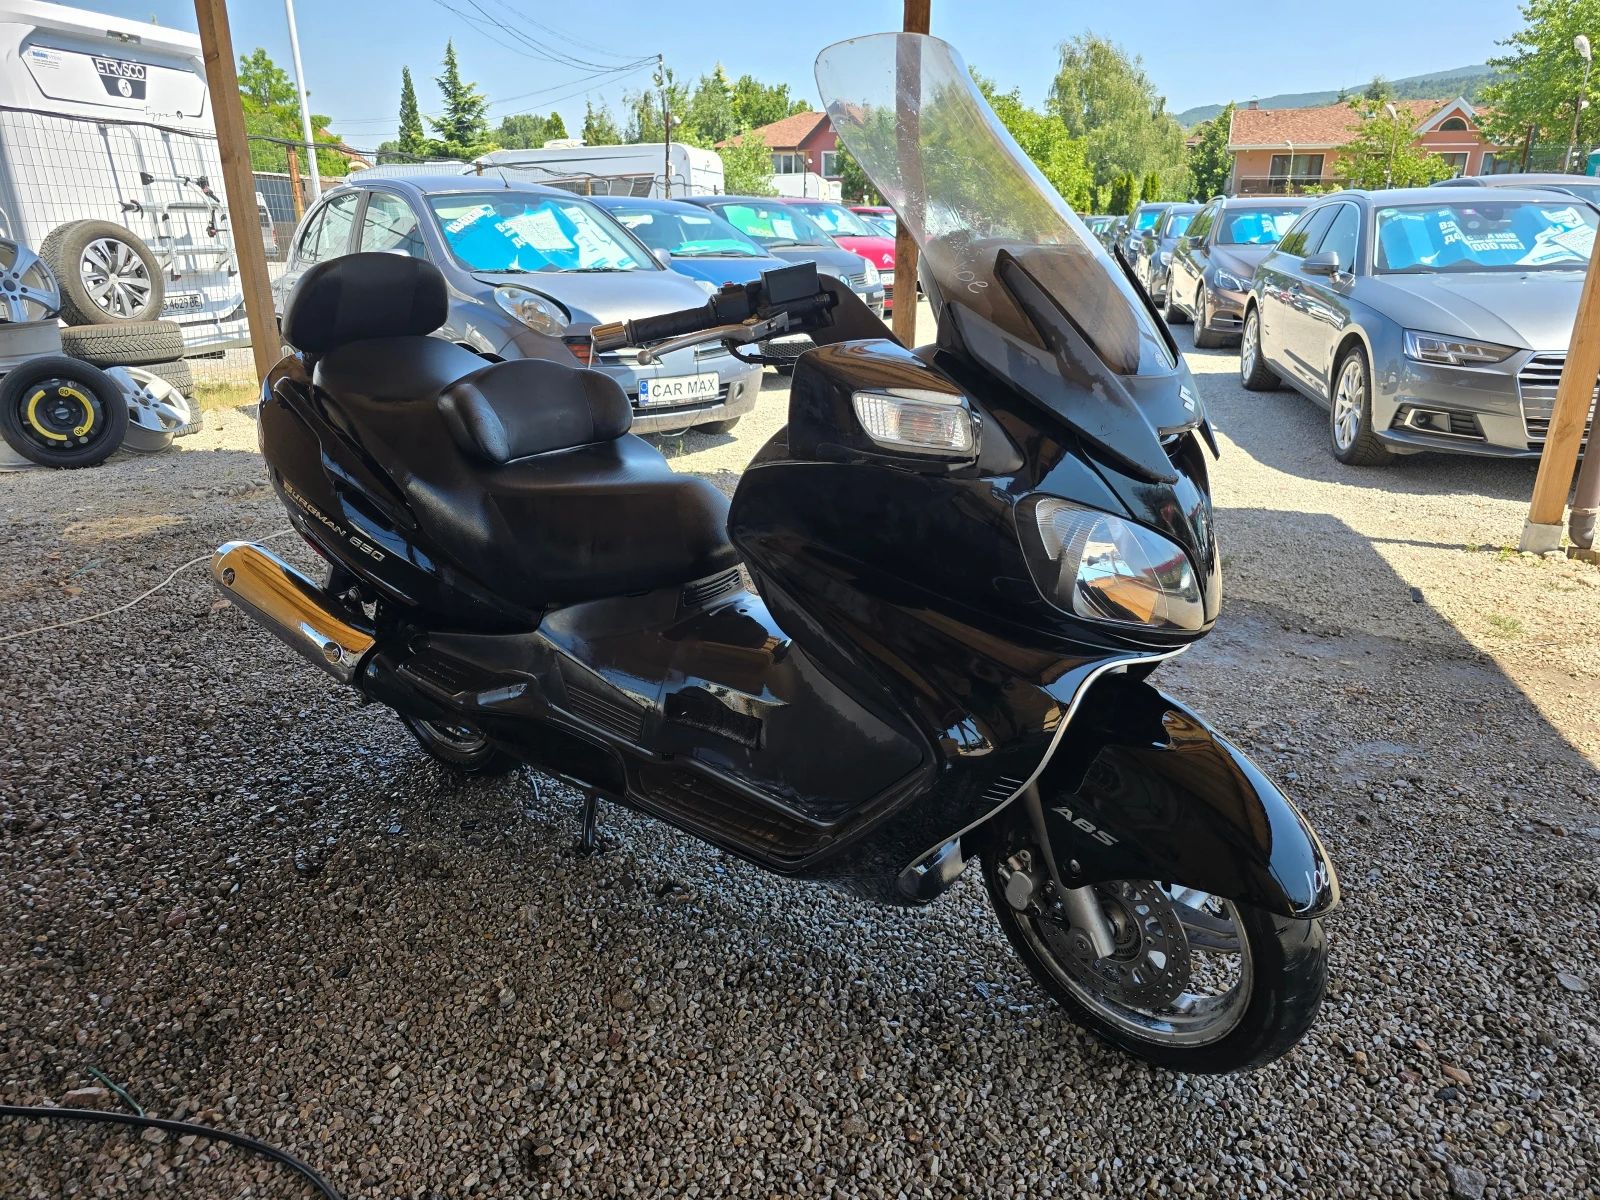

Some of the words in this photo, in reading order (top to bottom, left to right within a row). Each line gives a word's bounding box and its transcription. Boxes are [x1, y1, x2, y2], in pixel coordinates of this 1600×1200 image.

[170, 298, 188, 309] 4629
[652, 383, 683, 398] CAR
[687, 378, 715, 394] MAX
[283, 479, 346, 536] BURGMAN
[349, 536, 385, 562] 650
[1050, 806, 1119, 846] ABS
